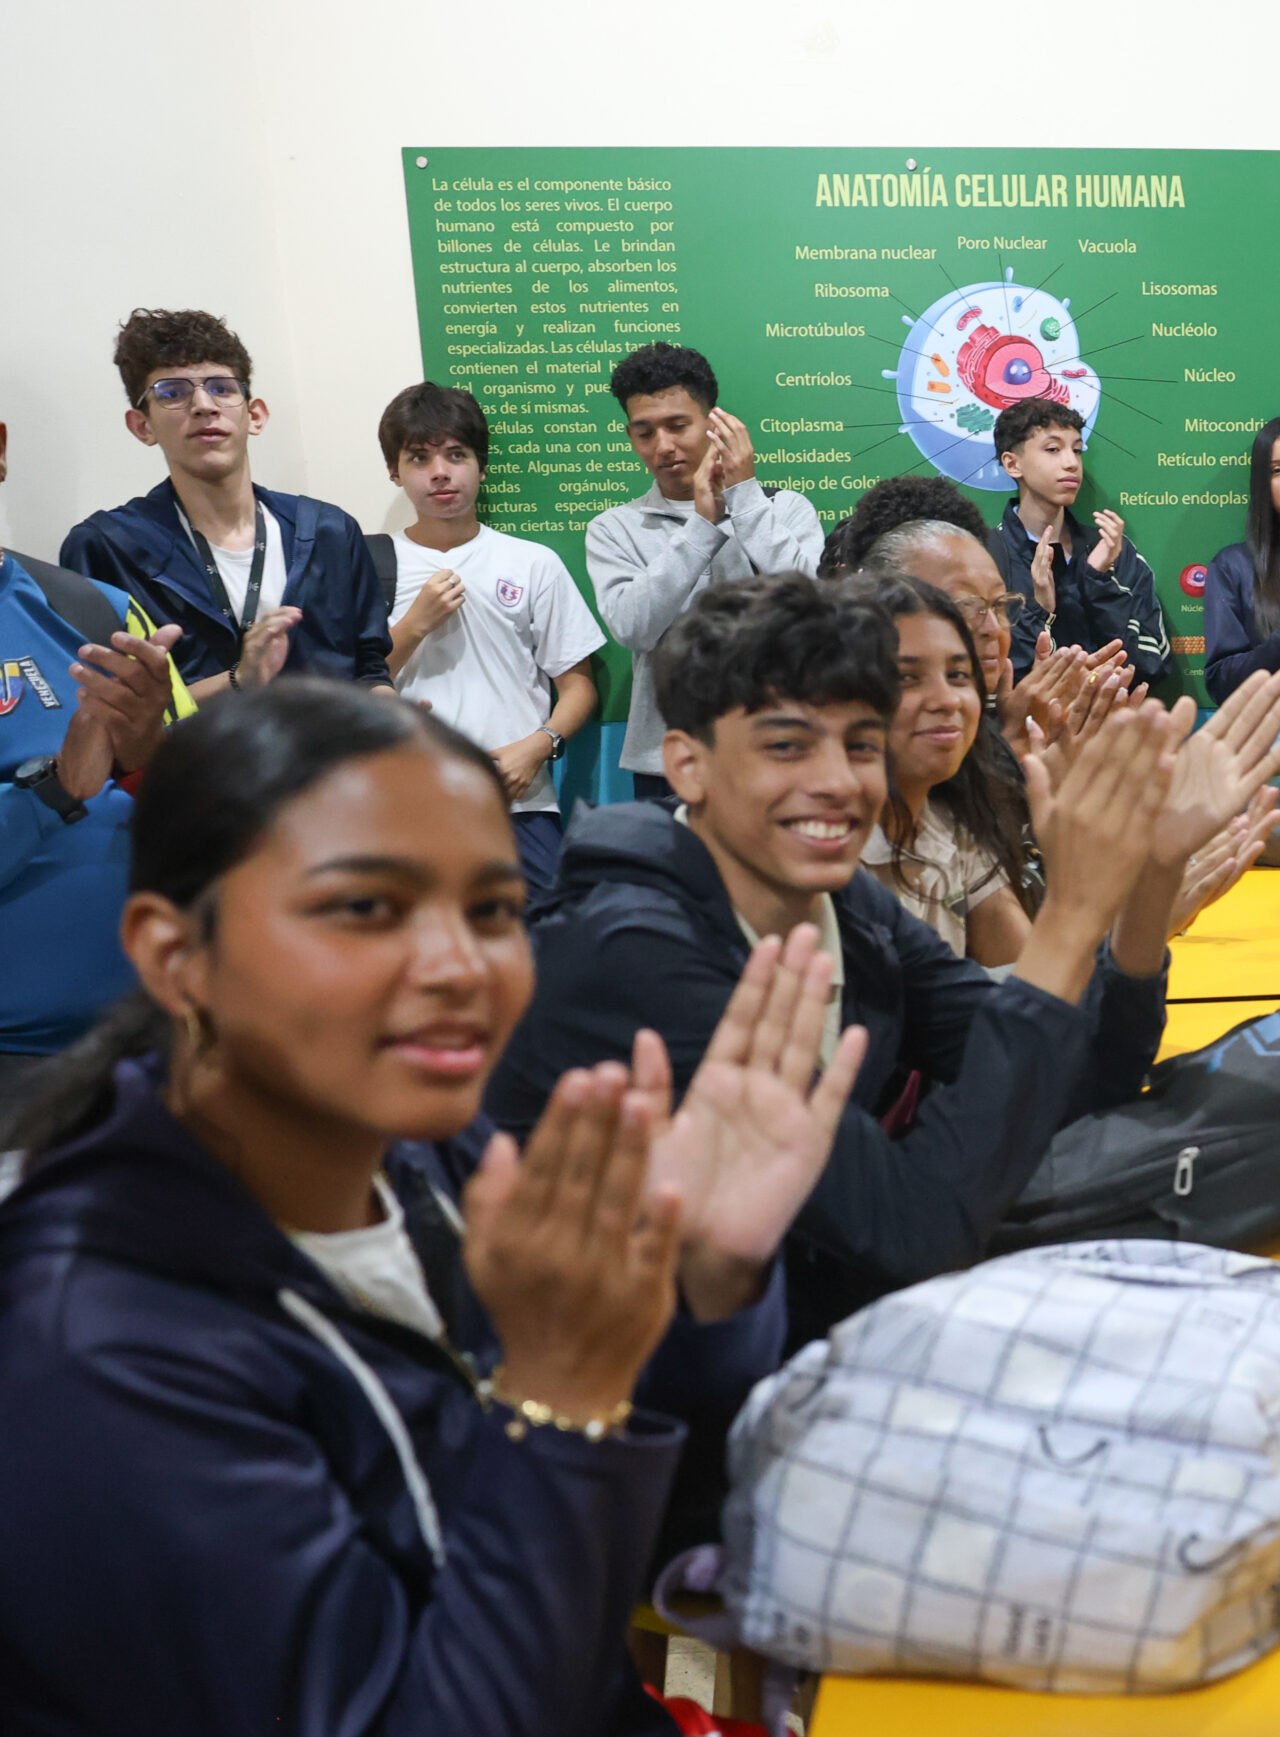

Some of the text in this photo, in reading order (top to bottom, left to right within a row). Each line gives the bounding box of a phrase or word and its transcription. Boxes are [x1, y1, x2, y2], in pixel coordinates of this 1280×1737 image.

[432, 176, 671, 194] La célula es el componente básico
[815, 167, 1185, 207] ANATOMÍA CELULAR HUMANA
[433, 197, 672, 214] de todos los seres vivos. El cuerpo
[435, 218, 674, 235] humano está compuesto por
[437, 238, 675, 252] billones de células. Le brindan
[957, 235, 1047, 249] Poro Nuclear
[1078, 238, 1136, 253] Vacuola
[795, 244, 936, 260] Membrana nuclear
[439, 258, 677, 276] estructura al cuerpo, absorben los
[441, 278, 678, 294] nutrientes de los alimentos,
[814, 282, 889, 297] Ribosoma
[1142, 281, 1218, 295] Lisosomas
[443, 300, 679, 314] convierten estos nutrientes en
[445, 319, 681, 337] energía y realizan funciones
[766, 321, 865, 337] Microtúbulos
[1152, 322, 1217, 336] Nucléolo
[447, 340, 548, 357] especializadas.
[550, 340, 573, 353] Las
[575, 339, 622, 353] células
[449, 361, 518, 374] contienen
[525, 360, 538, 374] el
[545, 359, 601, 373] material
[775, 371, 852, 386] Centríolos
[1184, 367, 1236, 382] Núcleo
[482, 381, 574, 397] organismo y
[499, 400, 518, 414] de
[520, 400, 530, 414] sí
[534, 400, 588, 413] mismas.
[488, 418, 625, 434] células constan de
[760, 417, 843, 435] Citoplasma
[1185, 418, 1266, 432] Mitocondri
[508, 440, 540, 453] cada
[545, 443, 571, 453] una
[576, 442, 601, 452] con
[606, 442, 632, 452] una
[753, 449, 851, 463] ovellosidades
[1157, 452, 1216, 466] Retículo
[527, 460, 582, 476] Algunas
[585, 459, 603, 472] de
[606, 460, 641, 472] estas
[558, 478, 629, 495] orgánulos,
[819, 476, 837, 489] de
[554, 498, 618, 513] especializ
[1119, 490, 1248, 507] Retículo endoplas
[520, 519, 564, 532] ciertas
[1181, 604, 1204, 612] Núcle
